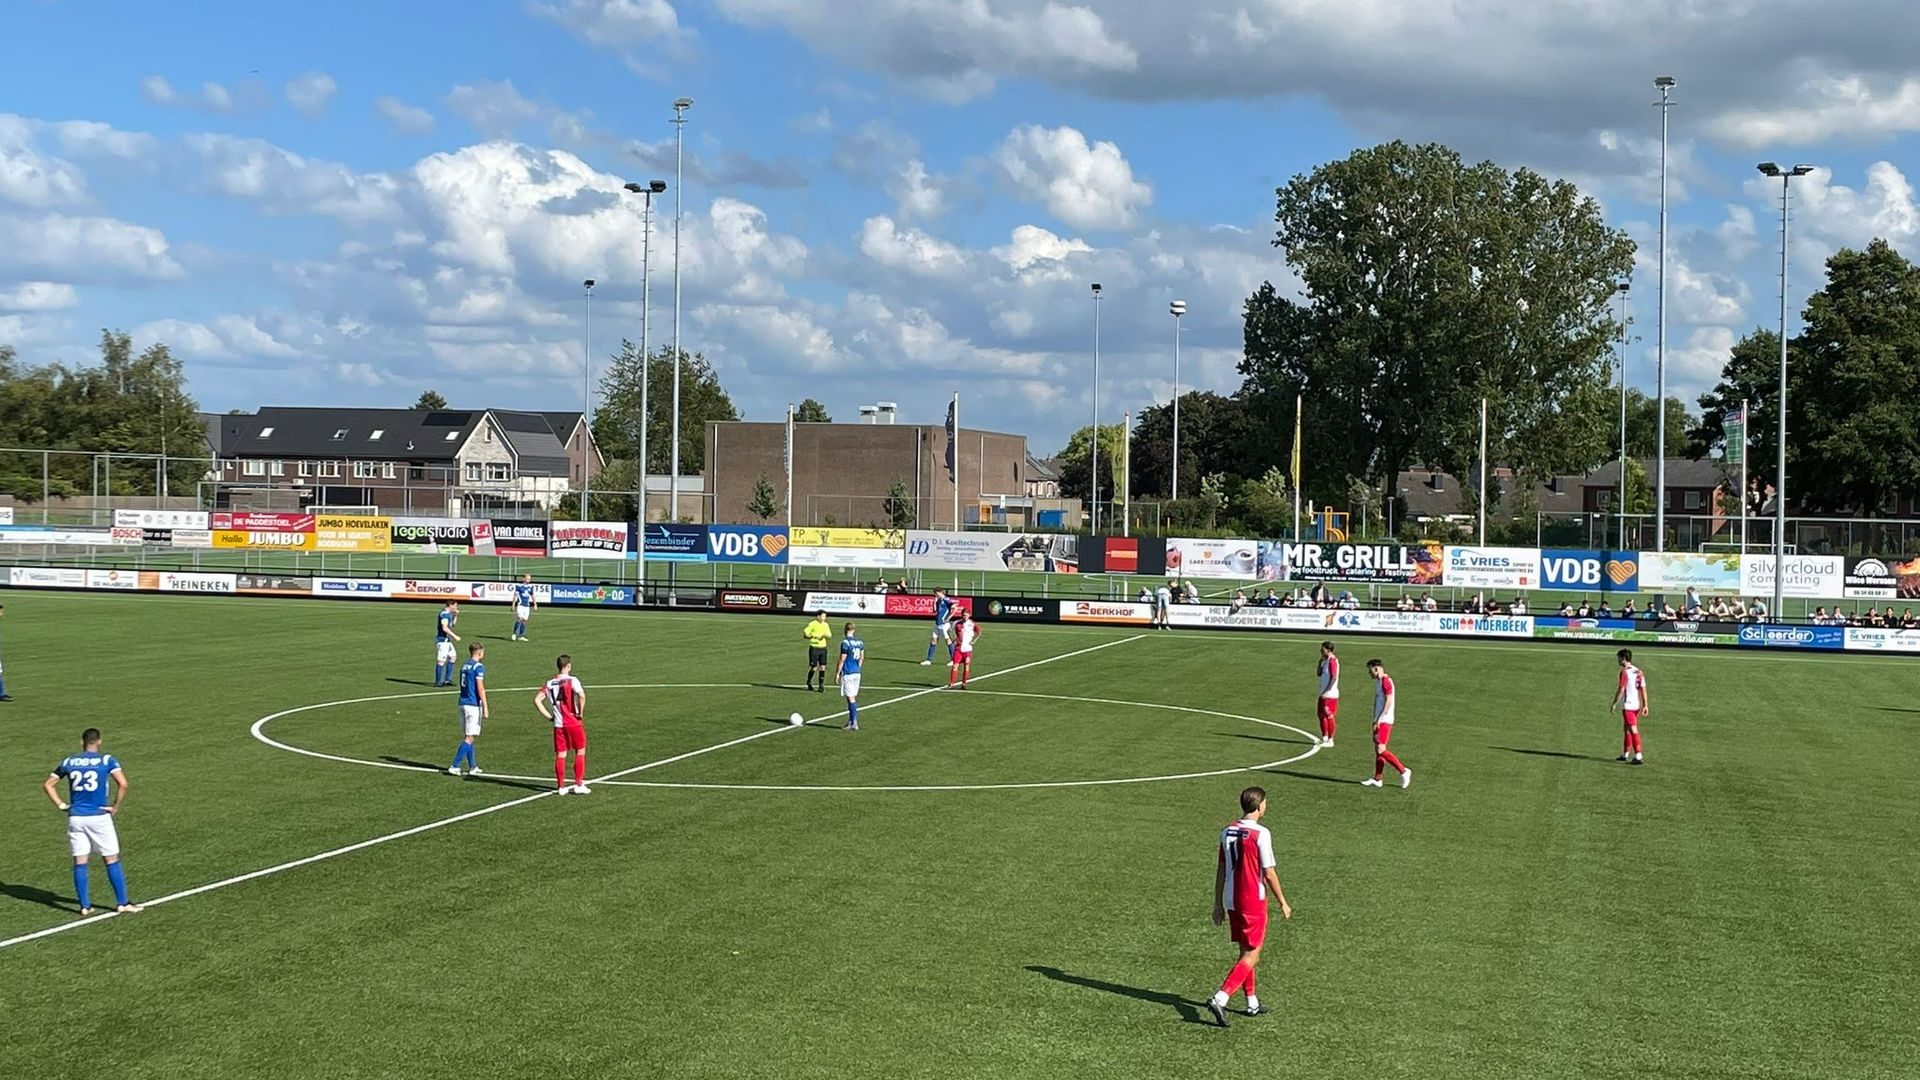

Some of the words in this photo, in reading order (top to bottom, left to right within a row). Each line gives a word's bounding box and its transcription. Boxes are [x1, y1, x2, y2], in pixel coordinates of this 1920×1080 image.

[318, 519, 343, 529] JUMBO
[112, 528, 142, 539] BOSCH
[393, 525, 468, 540] Tegelstudio
[494, 526, 512, 538] VAN
[247, 531, 306, 546] JUMBO
[709, 532, 758, 556] VDB
[1282, 543, 1330, 567] MR.
[1336, 545, 1417, 570] GRILL
[1451, 558, 1466, 566] DE
[1470, 557, 1510, 567] VRIES
[1301, 566, 1338, 576] foodtruck
[1345, 568, 1377, 577] catering
[1542, 557, 1601, 584] VDB
[1750, 560, 1834, 575] silvrcloud
[172, 580, 230, 591] HEINEKEN
[417, 585, 457, 593] BERKHOF
[488, 583, 505, 592] GBI
[553, 588, 594, 599] Heineken
[1090, 607, 1135, 616] BERKHOF
[69, 770, 99, 792] 23
